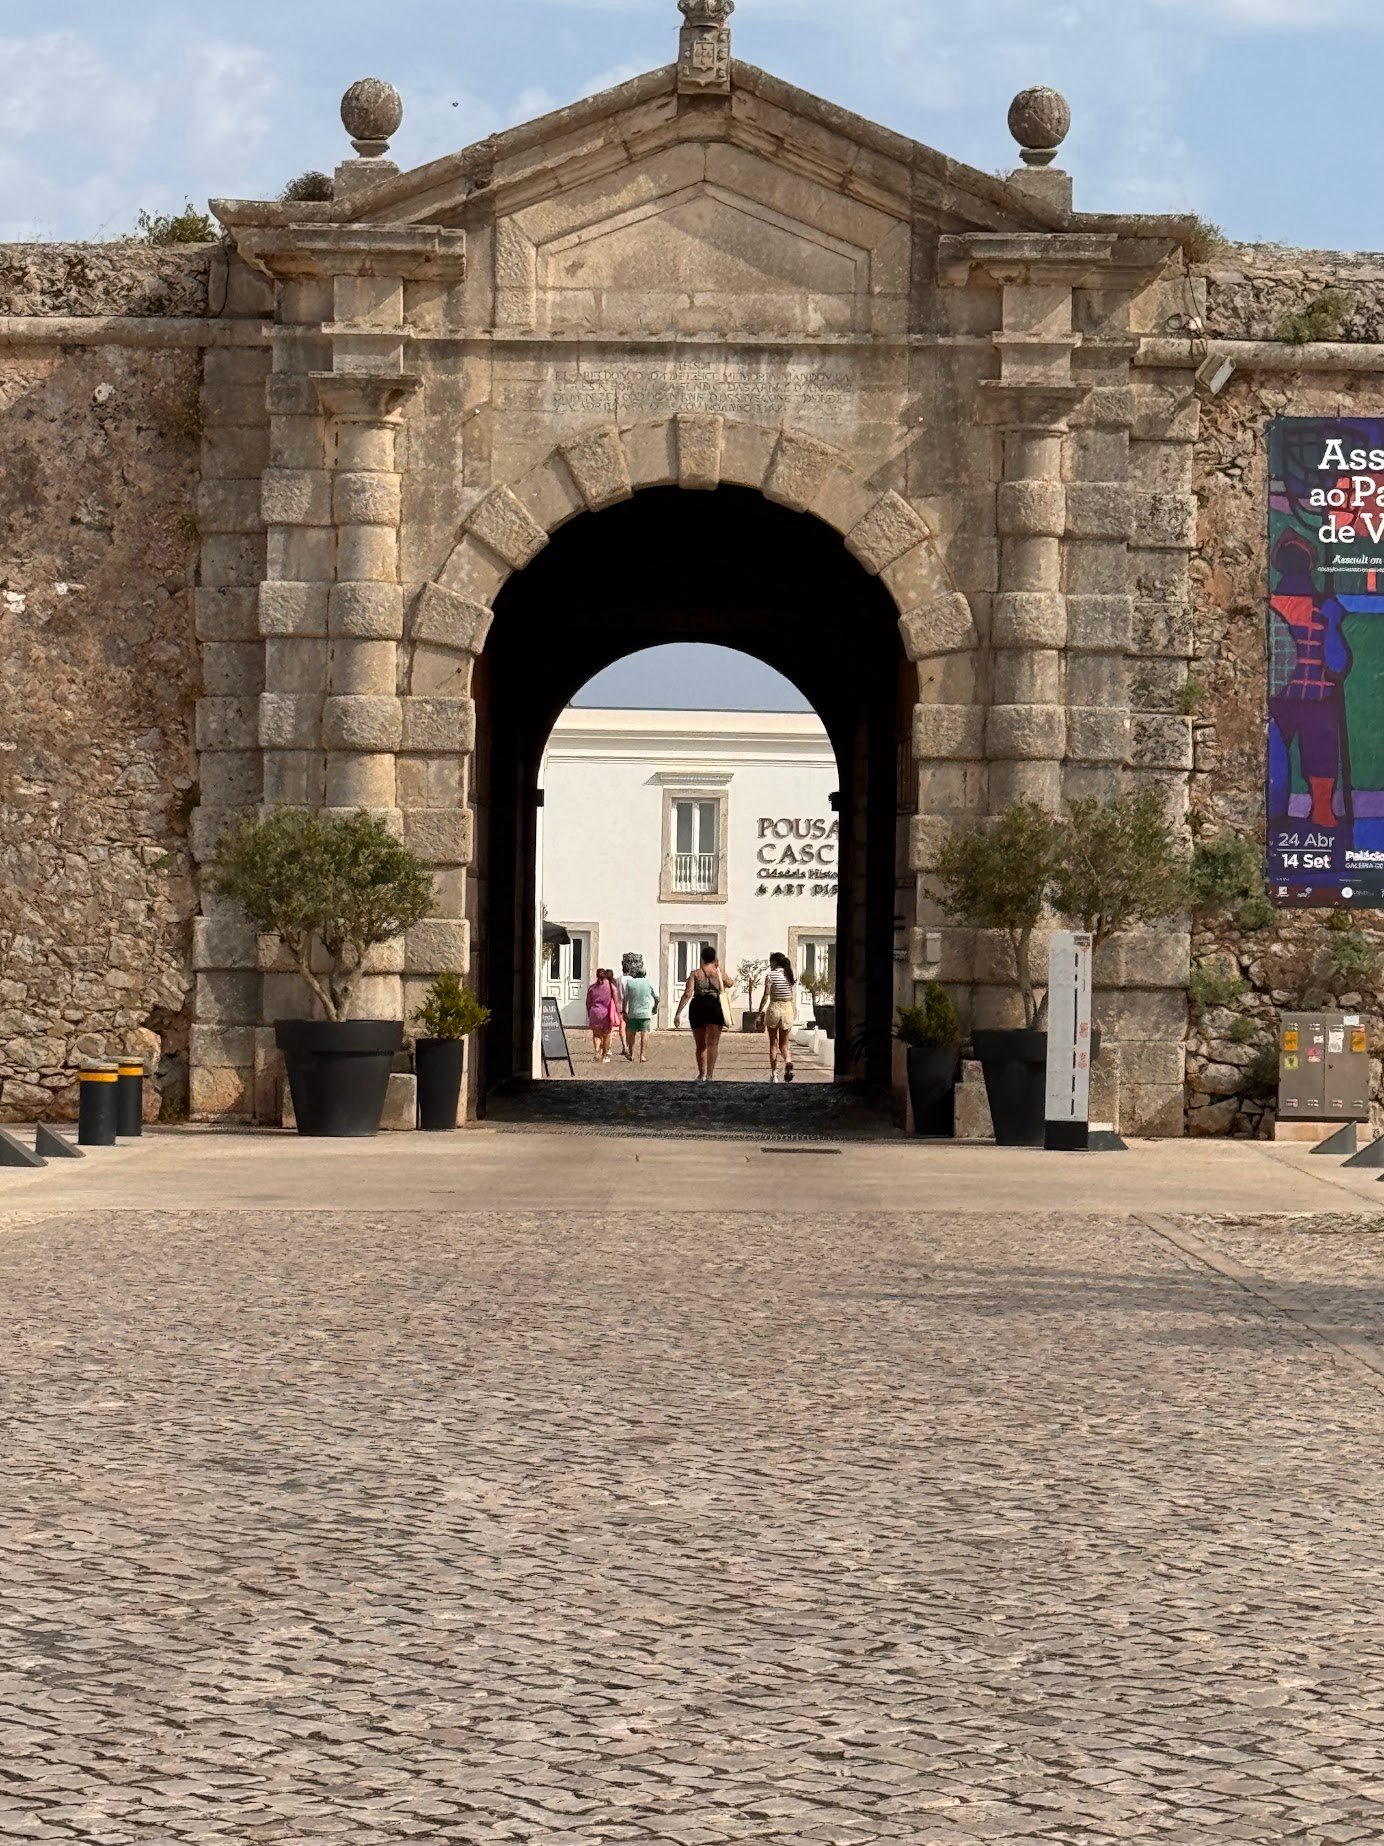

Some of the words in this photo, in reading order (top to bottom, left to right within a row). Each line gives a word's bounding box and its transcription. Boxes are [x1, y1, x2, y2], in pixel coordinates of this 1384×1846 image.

[1317, 438, 1384, 470] Ass
[1309, 488, 1346, 507] ao
[1318, 514, 1356, 544] de
[1360, 512, 1384, 544] V
[1278, 832, 1300, 847] 24
[1304, 832, 1335, 848] Abr
[756, 843, 839, 865] CASC
[1282, 853, 1299, 868] 14
[1303, 853, 1332, 869] Set
